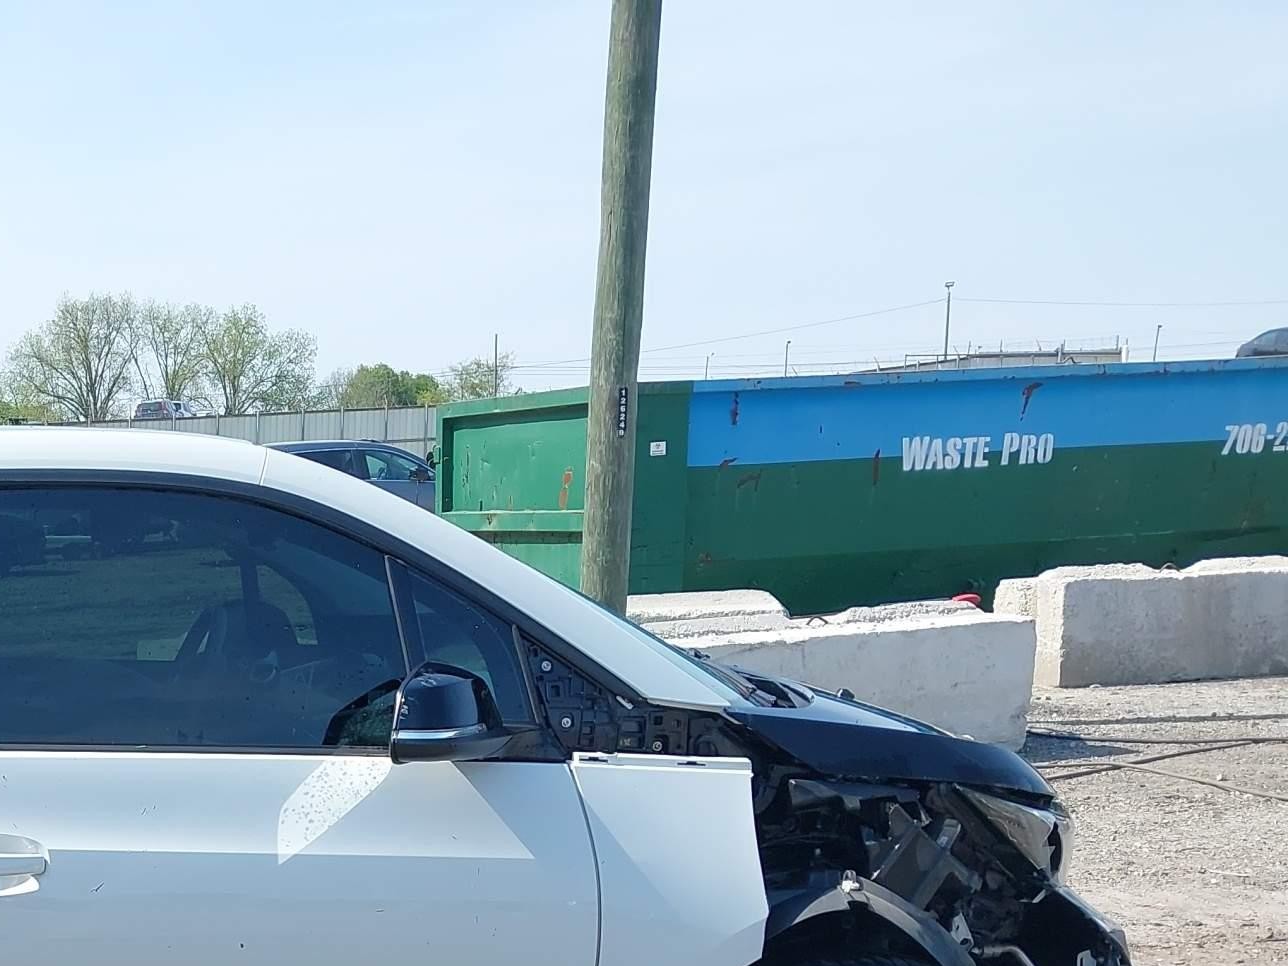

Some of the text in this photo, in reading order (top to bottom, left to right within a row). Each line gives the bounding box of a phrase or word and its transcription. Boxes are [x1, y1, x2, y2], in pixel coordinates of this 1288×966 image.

[902, 432, 1054, 471] WASTE PRO
[1221, 421, 1288, 455] 706-2
